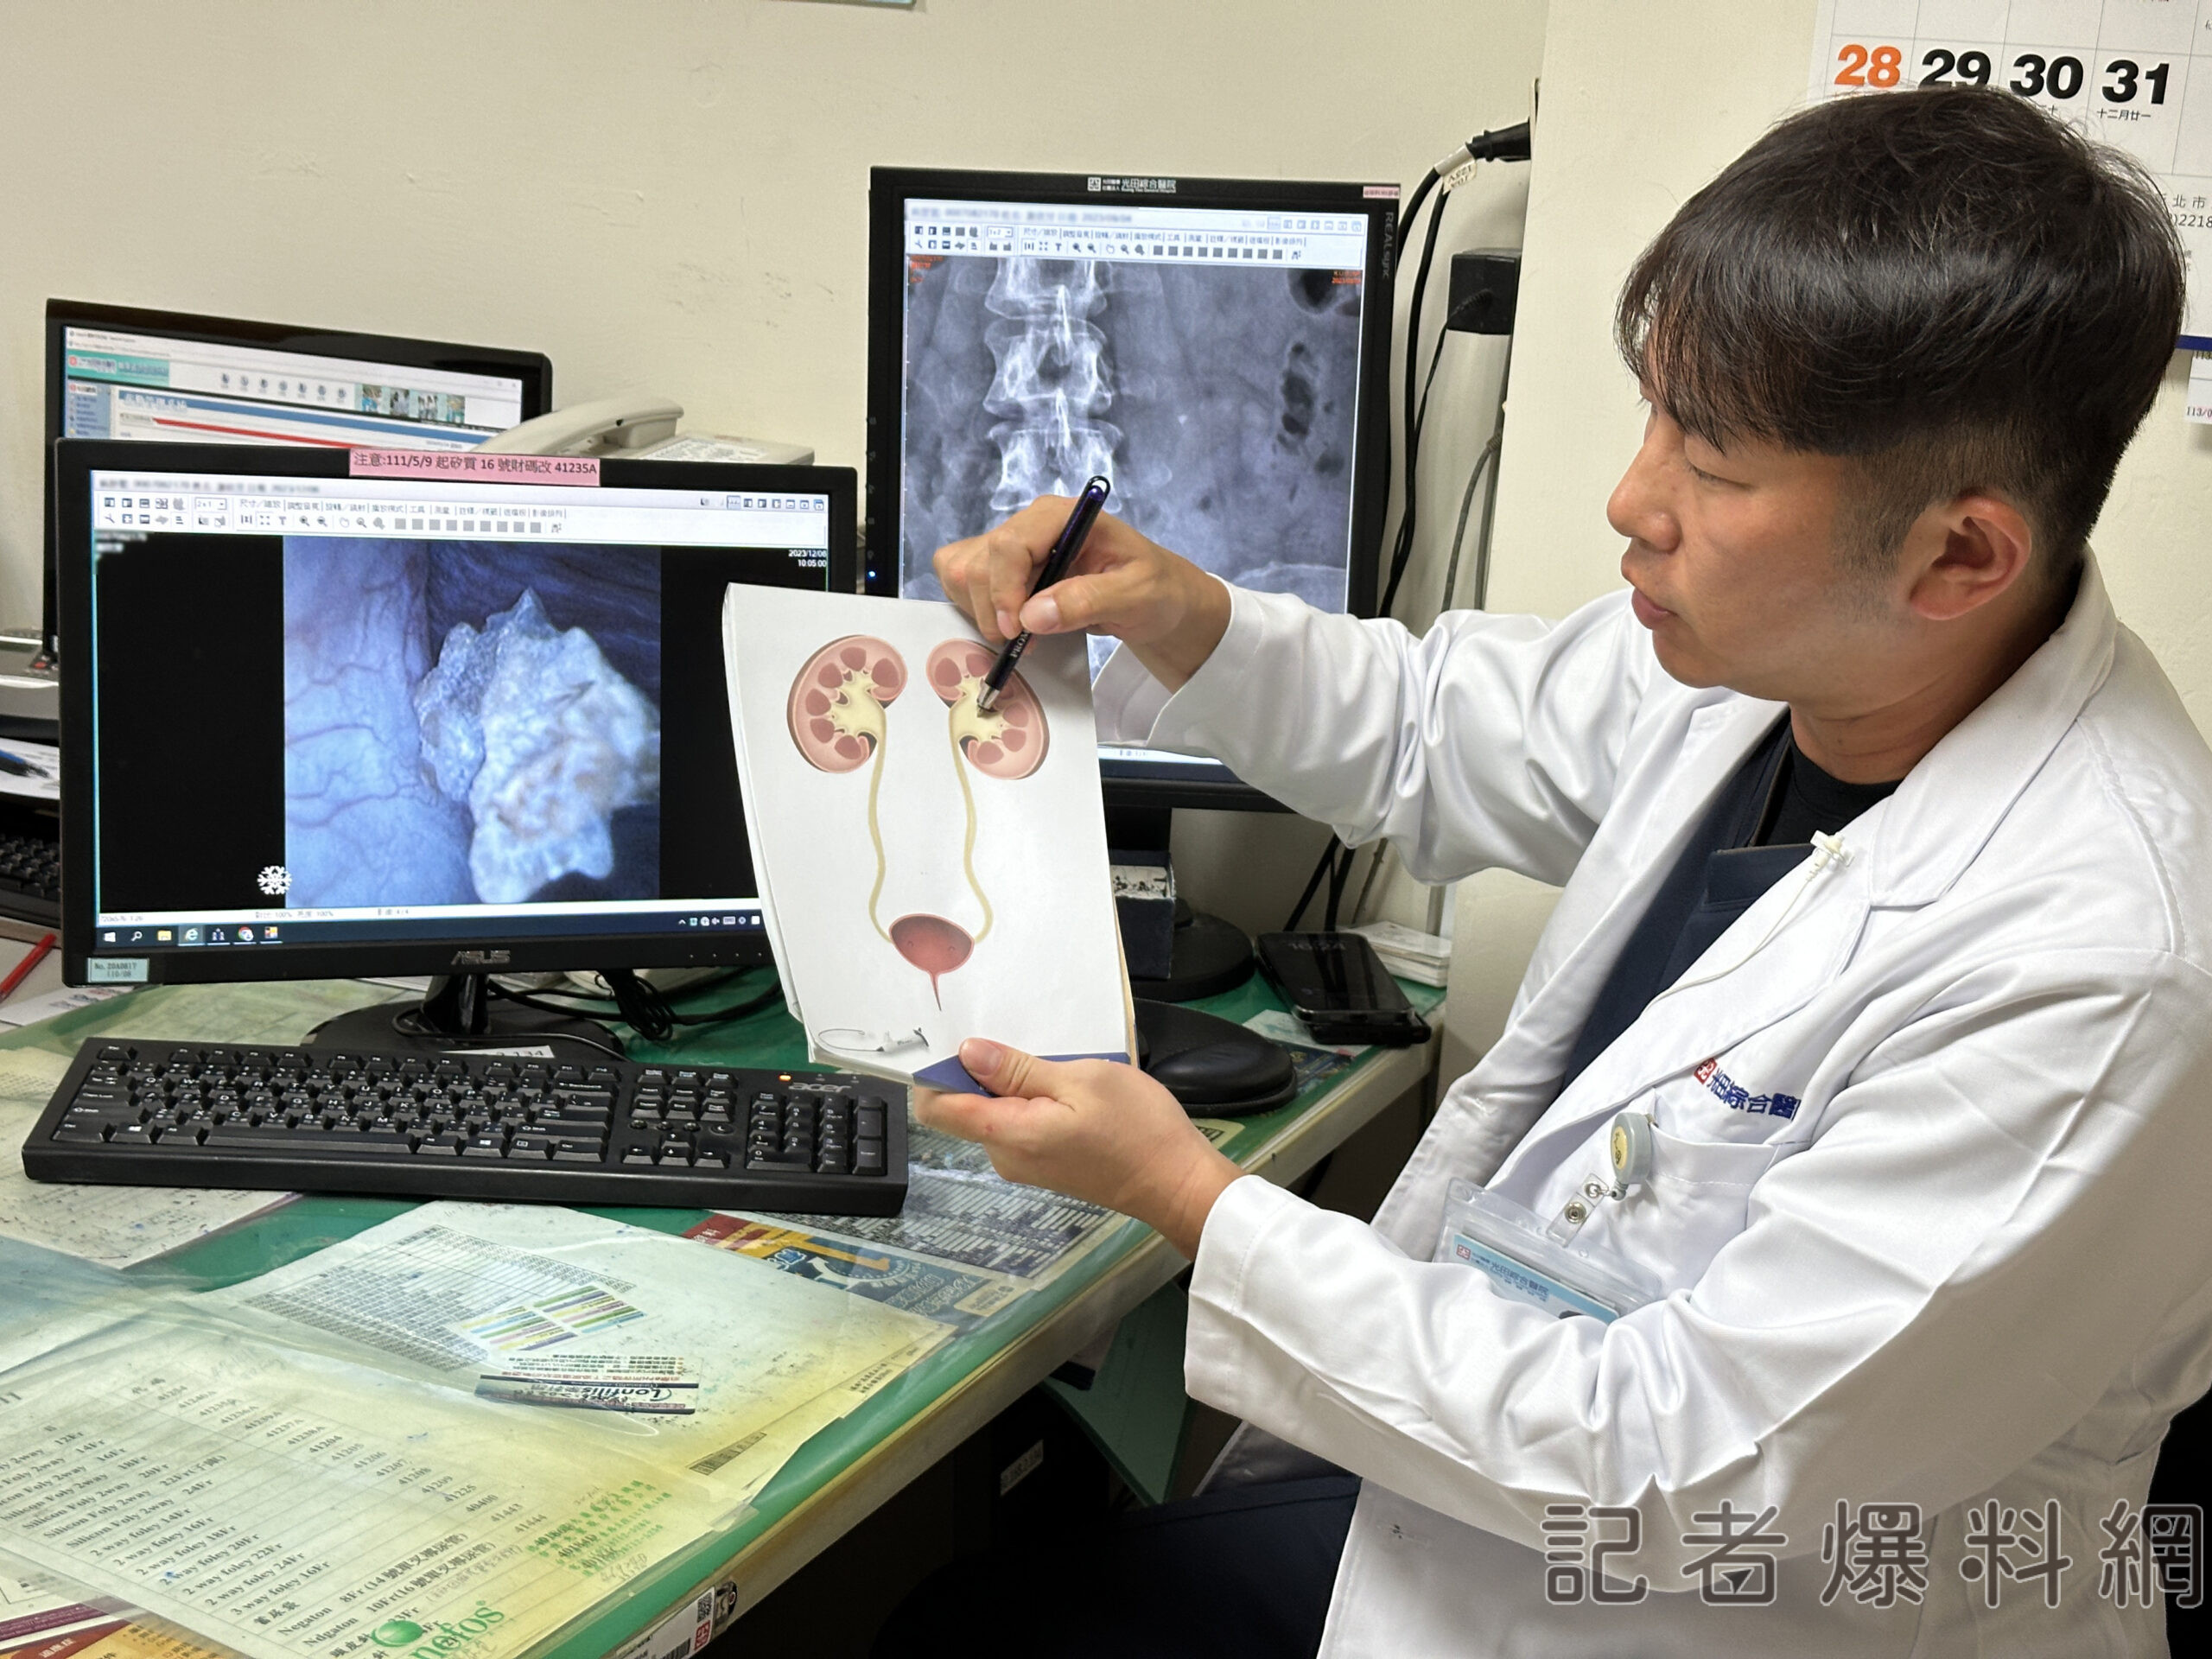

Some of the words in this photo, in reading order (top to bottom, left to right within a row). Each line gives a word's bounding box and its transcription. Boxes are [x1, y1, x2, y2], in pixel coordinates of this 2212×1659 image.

[1834, 44, 1902, 89] 28
[1918, 48, 1991, 90] 29
[2010, 54, 2083, 99] 30
[2102, 60, 2170, 105] 31
[2097, 108, 2152, 121] 十二月廿一
[353, 452, 432, 467] 注意:111/5/9
[480, 458, 494, 469] 16
[554, 461, 597, 474] 41235A
[451, 950, 511, 965] ASUS
[788, 1082, 852, 1093] acer
[1707, 1067, 1802, 1122] 光田綜合醫
[103, 1537, 130, 1552] way
[129, 1522, 162, 1540] foley
[161, 1507, 192, 1524] 14Fr
[126, 1546, 153, 1560] way
[151, 1530, 184, 1548] foley
[182, 1516, 214, 1533] 16Fr
[149, 1555, 176, 1570] way
[174, 1539, 207, 1557] foley
[206, 1524, 238, 1541] 18Fr
[232, 1607, 243, 1616] 3
[243, 1593, 271, 1610] way
[268, 1577, 302, 1597] foley
[299, 1560, 331, 1580] 16Fr
[444, 1484, 477, 1503] 41225
[173, 1565, 200, 1580] way
[198, 1549, 230, 1567] foley
[228, 1533, 260, 1551] 20Fr
[195, 1575, 223, 1589] way
[220, 1557, 254, 1576] foley
[251, 1542, 284, 1560] 22Fr
[205, 1598, 218, 1606] 2
[218, 1584, 245, 1601] way
[243, 1568, 276, 1587] foley
[273, 1552, 306, 1571] 24Fr
[277, 1605, 334, 1636] Negaton
[339, 1587, 365, 1604] 8Fr
[302, 1616, 359, 1648] Ndgaton
